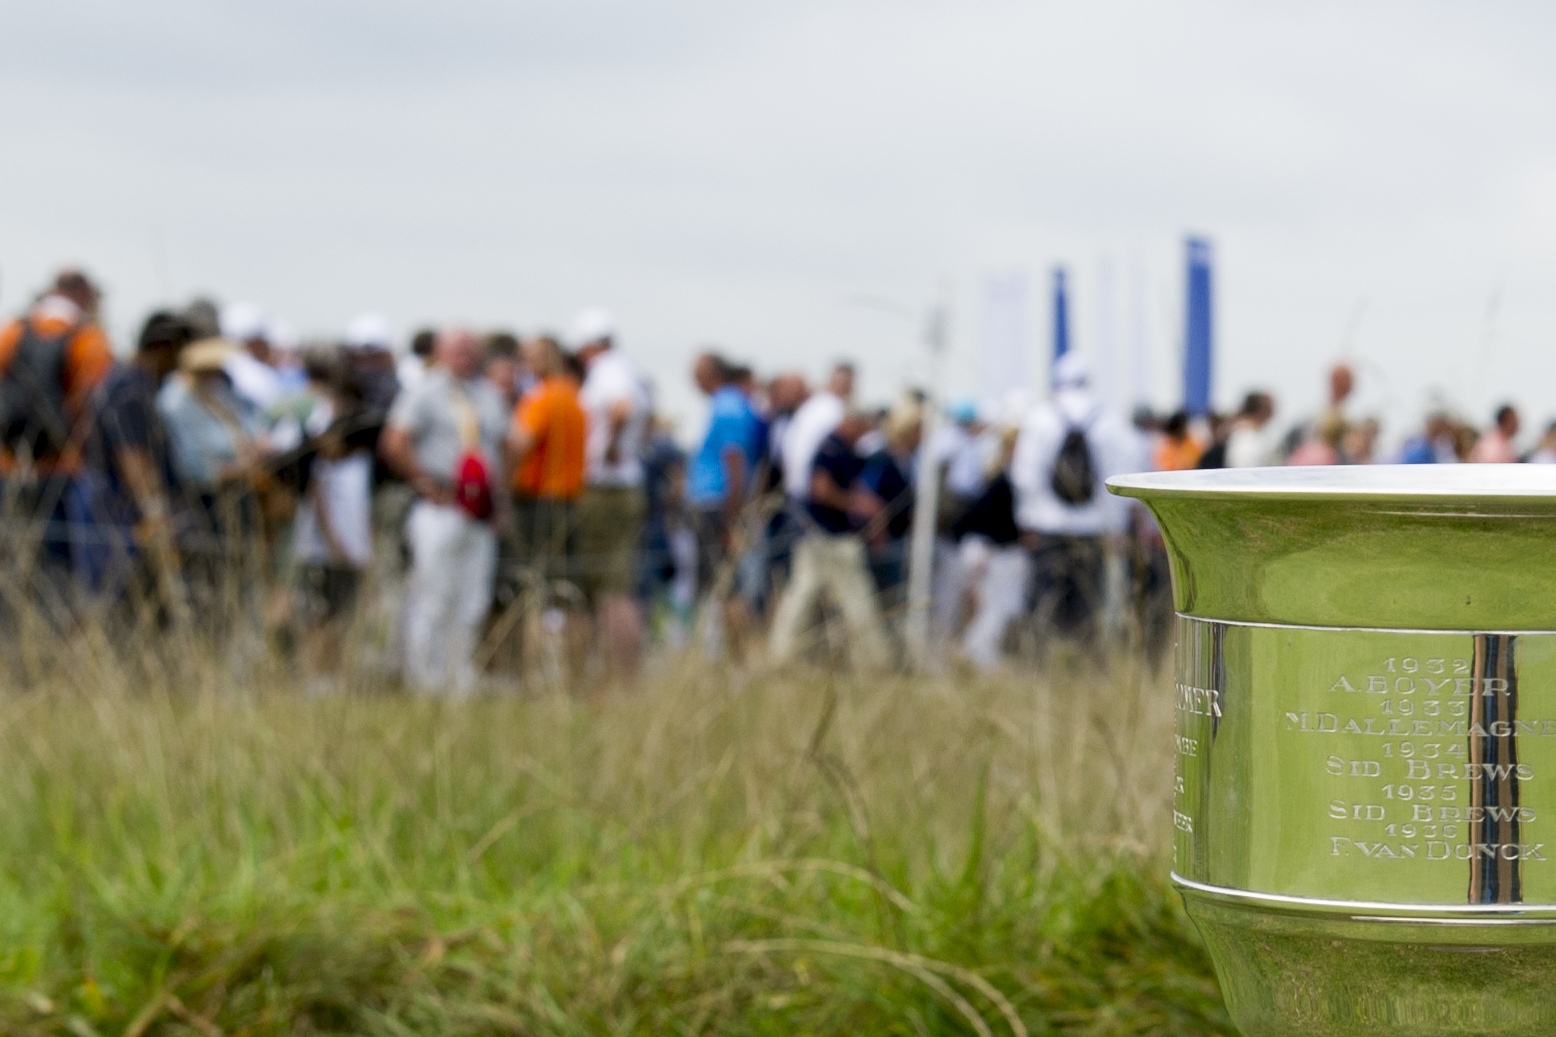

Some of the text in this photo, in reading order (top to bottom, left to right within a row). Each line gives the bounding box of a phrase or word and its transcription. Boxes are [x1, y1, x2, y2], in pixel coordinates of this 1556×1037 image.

[1383, 657, 1470, 674] 1932
[1380, 699, 1467, 717] 1933
[1382, 741, 1467, 759] 1934
[1325, 755, 1535, 782] SID BREWS
[1382, 784, 1458, 801] 1935
[1327, 800, 1537, 823] SID BREWS
[1425, 841, 1548, 862] DONCK
